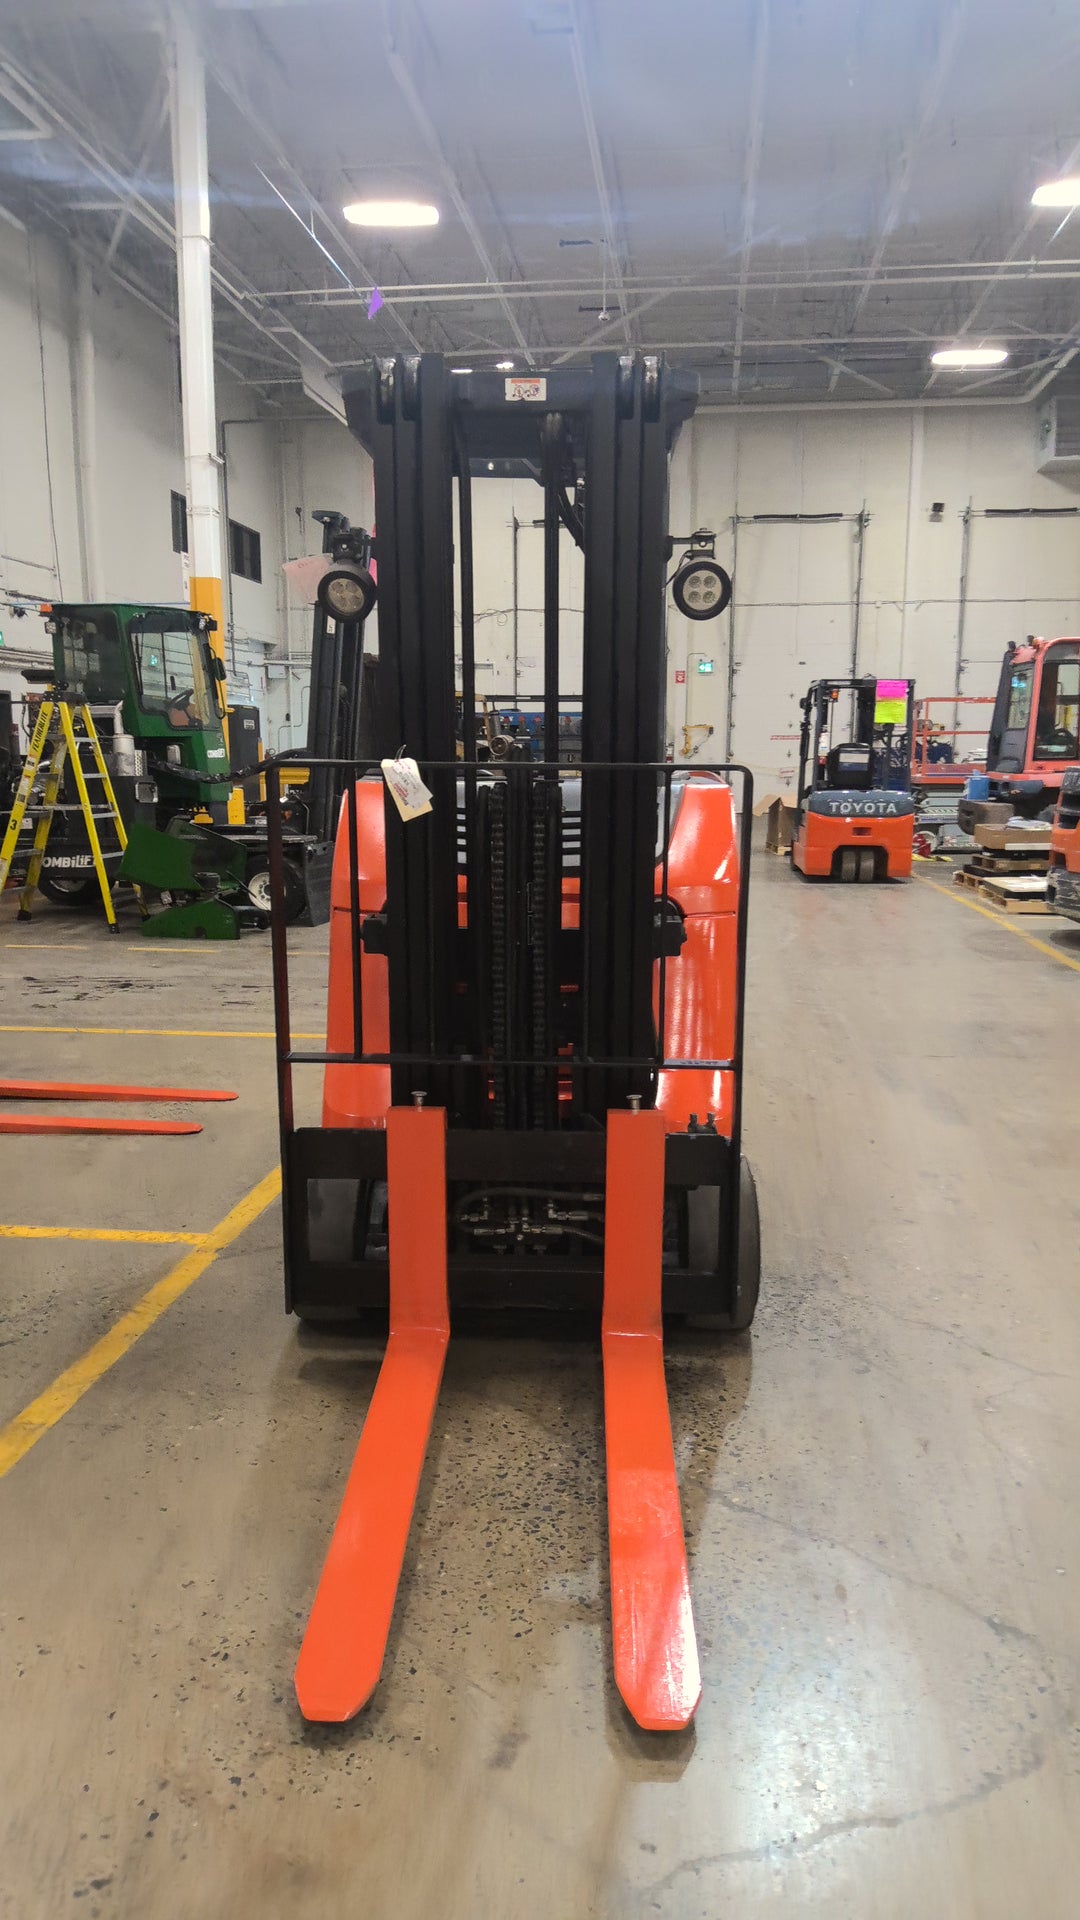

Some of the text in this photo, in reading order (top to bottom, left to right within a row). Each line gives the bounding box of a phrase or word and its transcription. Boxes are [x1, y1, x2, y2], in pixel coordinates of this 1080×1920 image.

[32, 711, 48, 752] FEATHERLITE
[829, 802, 897, 813] TOYOTA
[9, 819, 18, 830] 3
[42, 855, 96, 868] OMBiLiF
